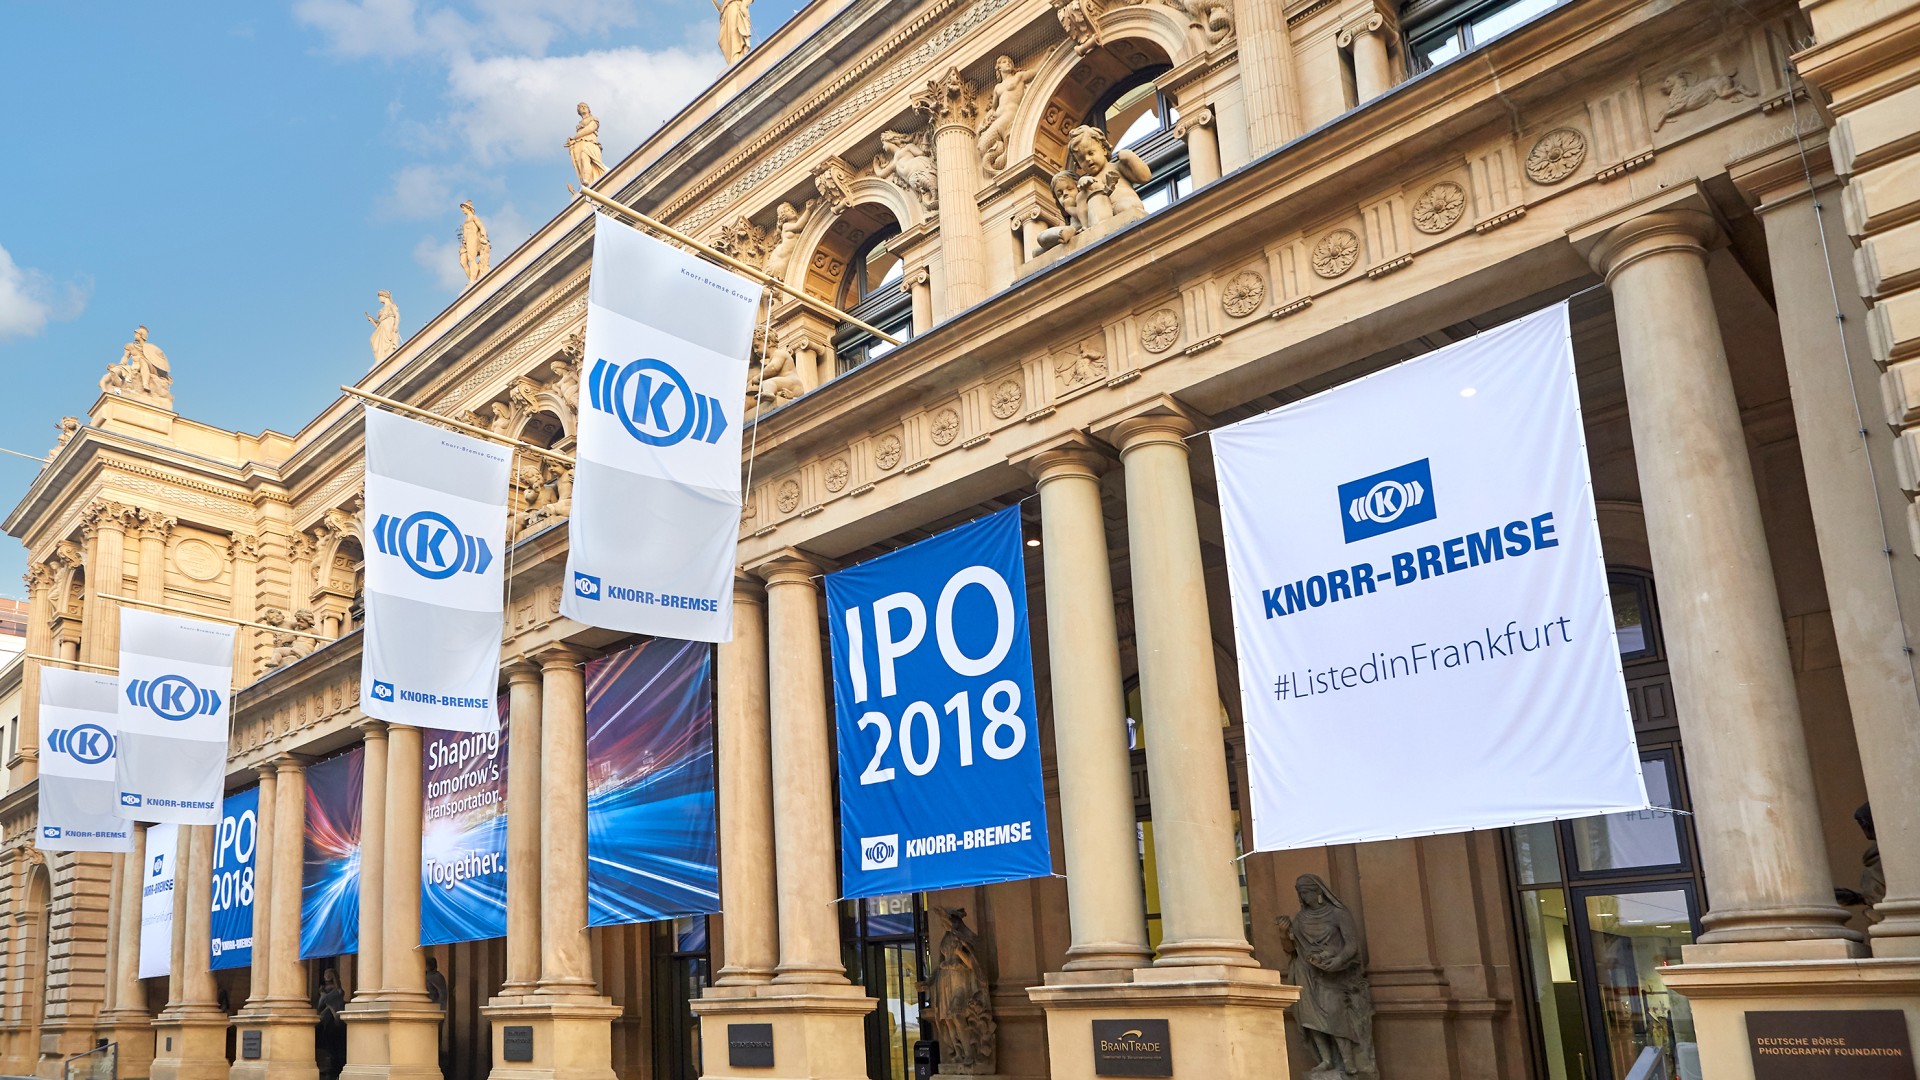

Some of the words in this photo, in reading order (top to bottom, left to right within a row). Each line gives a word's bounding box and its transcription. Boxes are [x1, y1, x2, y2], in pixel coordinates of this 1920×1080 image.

[680, 268, 730, 294] Knorr-Bremse
[731, 290, 753, 304] Group
[632, 373, 676, 433] K
[441, 440, 485, 457] Knorr-Bremse
[416, 523, 449, 568] K
[1261, 511, 1559, 620] KNORR-BREMSE
[607, 585, 718, 612] KNORR-BREMSE
[845, 565, 1015, 704] IPO
[1273, 616, 1573, 701] #ListedinFrankfurt
[160, 683, 187, 713] K
[400, 689, 489, 709] KNORR-BREMSE
[78, 731, 102, 757] K
[857, 679, 1027, 786] 2018
[428, 731, 500, 771] Shaping
[146, 797, 215, 810] KNORR-BREMSE
[427, 789, 503, 821] transportation.
[65, 830, 127, 839] KNORR-BREMSE
[212, 809, 258, 870] IPO
[905, 821, 1032, 858] KNORR-BREMSE
[426, 851, 504, 890] Together.
[211, 866, 255, 912] 2018
[1757, 1037, 1809, 1046] DEUTSCHE
[1812, 1036, 1846, 1046] BÖRSE
[1758, 1047, 1831, 1056] PHOTOGRAPHY
[1834, 1048, 1902, 1056] FOUNDATION
